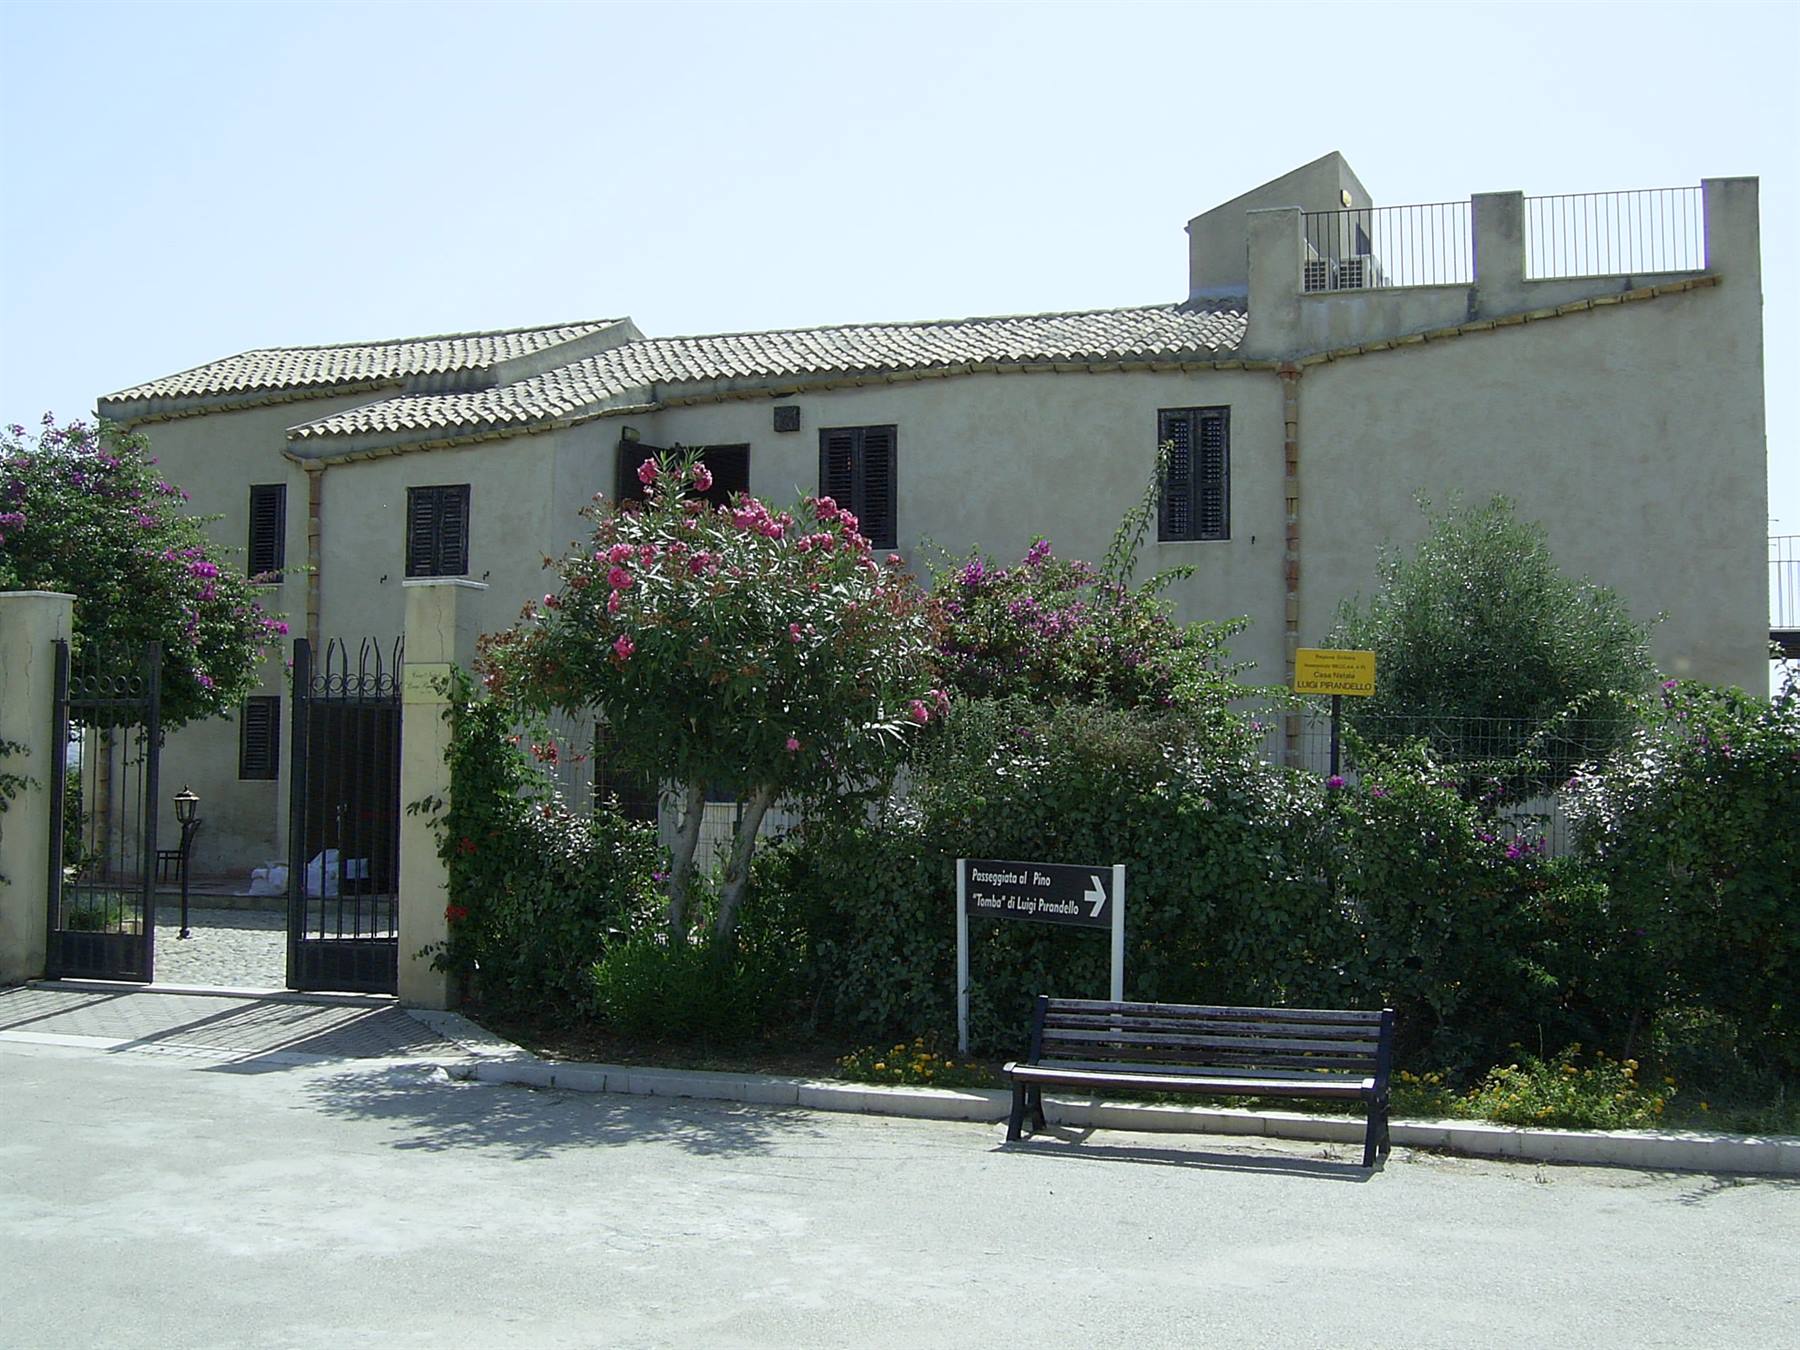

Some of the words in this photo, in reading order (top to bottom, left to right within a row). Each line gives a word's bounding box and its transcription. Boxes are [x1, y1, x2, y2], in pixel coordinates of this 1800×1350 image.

[1297, 680, 1317, 688] LUIGI
[1320, 681, 1372, 690] PIRANDELLO
[972, 868, 1017, 886] Passeggiata
[1018, 871, 1027, 885] al
[1033, 872, 1051, 886] Pino
[1007, 896, 1016, 909] di
[1017, 897, 1037, 914] Luigi
[1038, 898, 1079, 915] Pirandello
